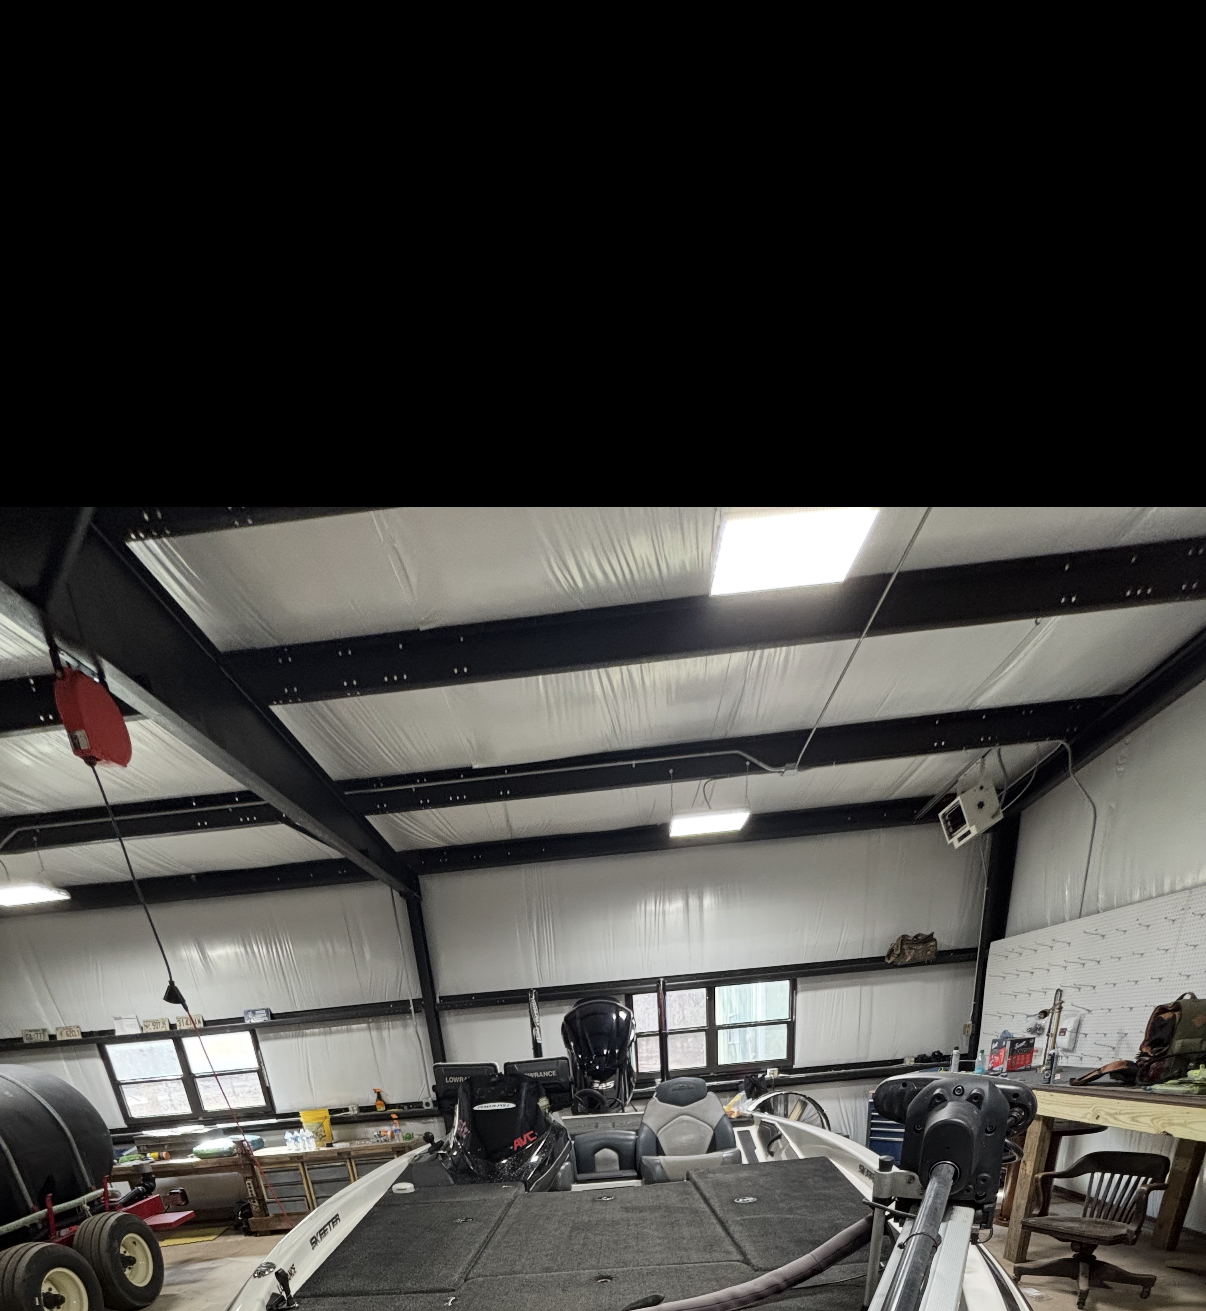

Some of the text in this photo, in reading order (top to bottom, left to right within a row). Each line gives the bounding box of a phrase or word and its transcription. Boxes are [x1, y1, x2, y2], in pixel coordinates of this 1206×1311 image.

[445, 1075, 470, 1084] LOWRA
[524, 1070, 557, 1079] WRANCE
[513, 1130, 538, 1151] AVC
[310, 1213, 341, 1250] SKEETER
